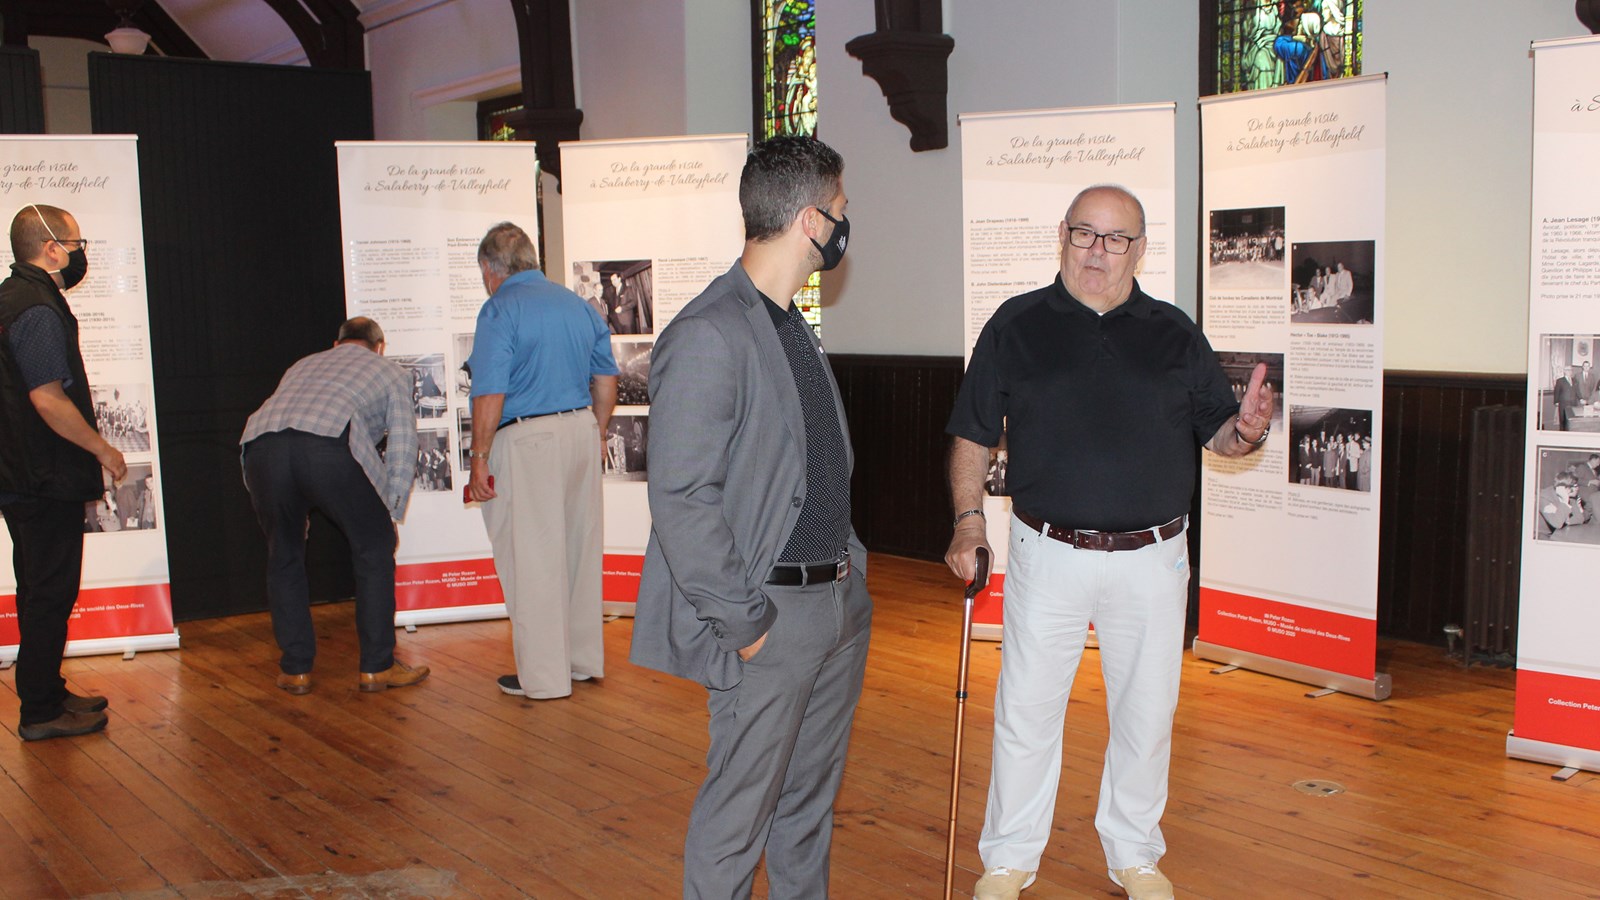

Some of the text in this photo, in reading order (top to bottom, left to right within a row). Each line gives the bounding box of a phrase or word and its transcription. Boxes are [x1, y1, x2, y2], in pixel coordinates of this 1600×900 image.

[1571, 99, 1584, 112] à
[1247, 112, 1339, 134] De la grande visite
[1010, 133, 1116, 151] De la grande visite
[1226, 125, 1365, 153] à Salaberry-de-Valleyfield
[986, 147, 1146, 169] à Salaberry-de-Valleyfield
[3, 160, 79, 177] grande visite
[387, 164, 486, 180] De la grande visite
[610, 159, 704, 176] De la grande visite
[0, 176, 110, 193] ry-de-Valleyfield
[364, 179, 512, 196] à Salaberry-de-Valleyfield
[590, 172, 730, 191] à Salaberry-de-Valleyfield
[1566, 216, 1590, 224] Lesage
[1547, 697, 1582, 709] Collection
